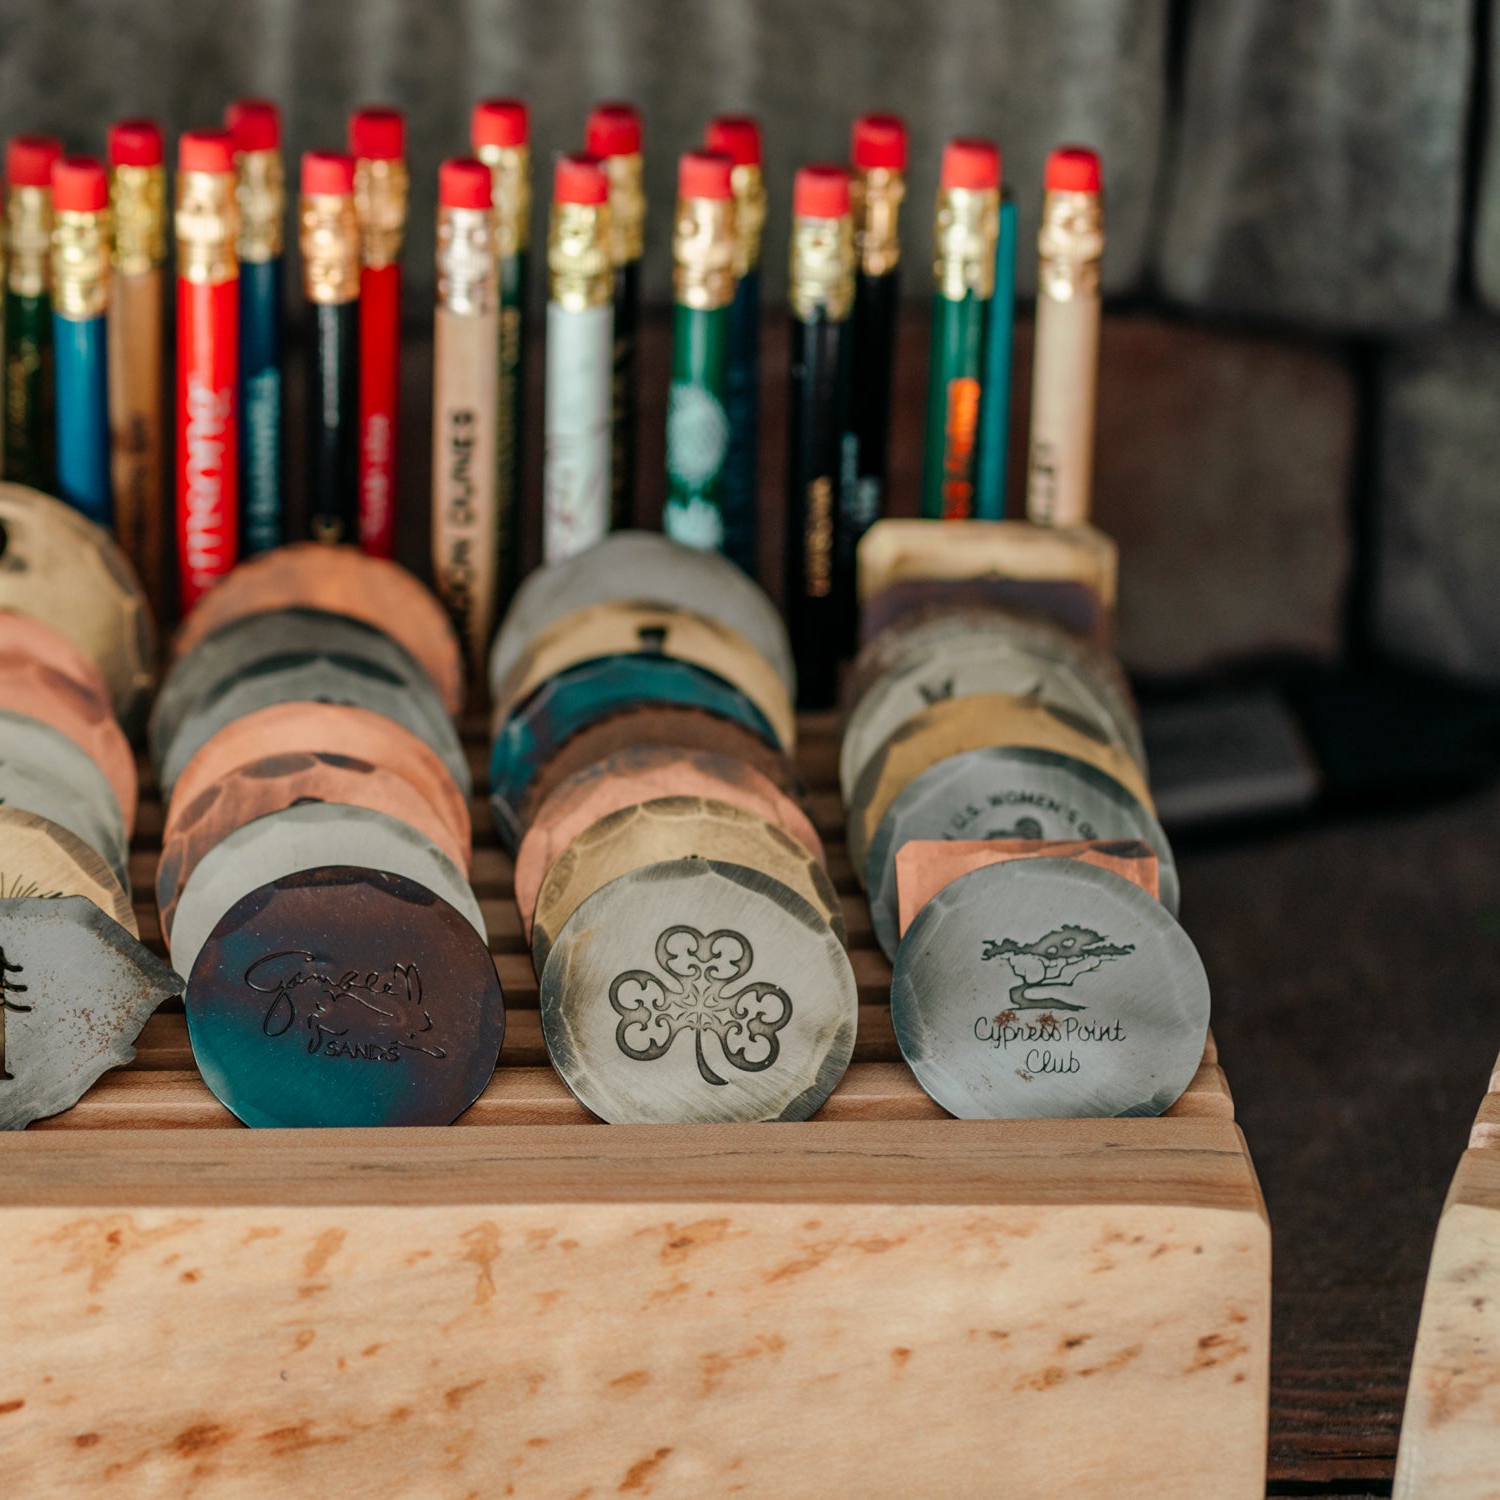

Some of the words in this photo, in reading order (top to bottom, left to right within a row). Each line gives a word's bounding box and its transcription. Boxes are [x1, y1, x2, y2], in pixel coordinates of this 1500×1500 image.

[448, 407, 477, 528] DUNES
[974, 1016, 1062, 1049] Cypress
[1062, 1016, 1127, 1042] Point
[324, 1040, 401, 1062] SANDS
[1026, 1048, 1080, 1073] Club
